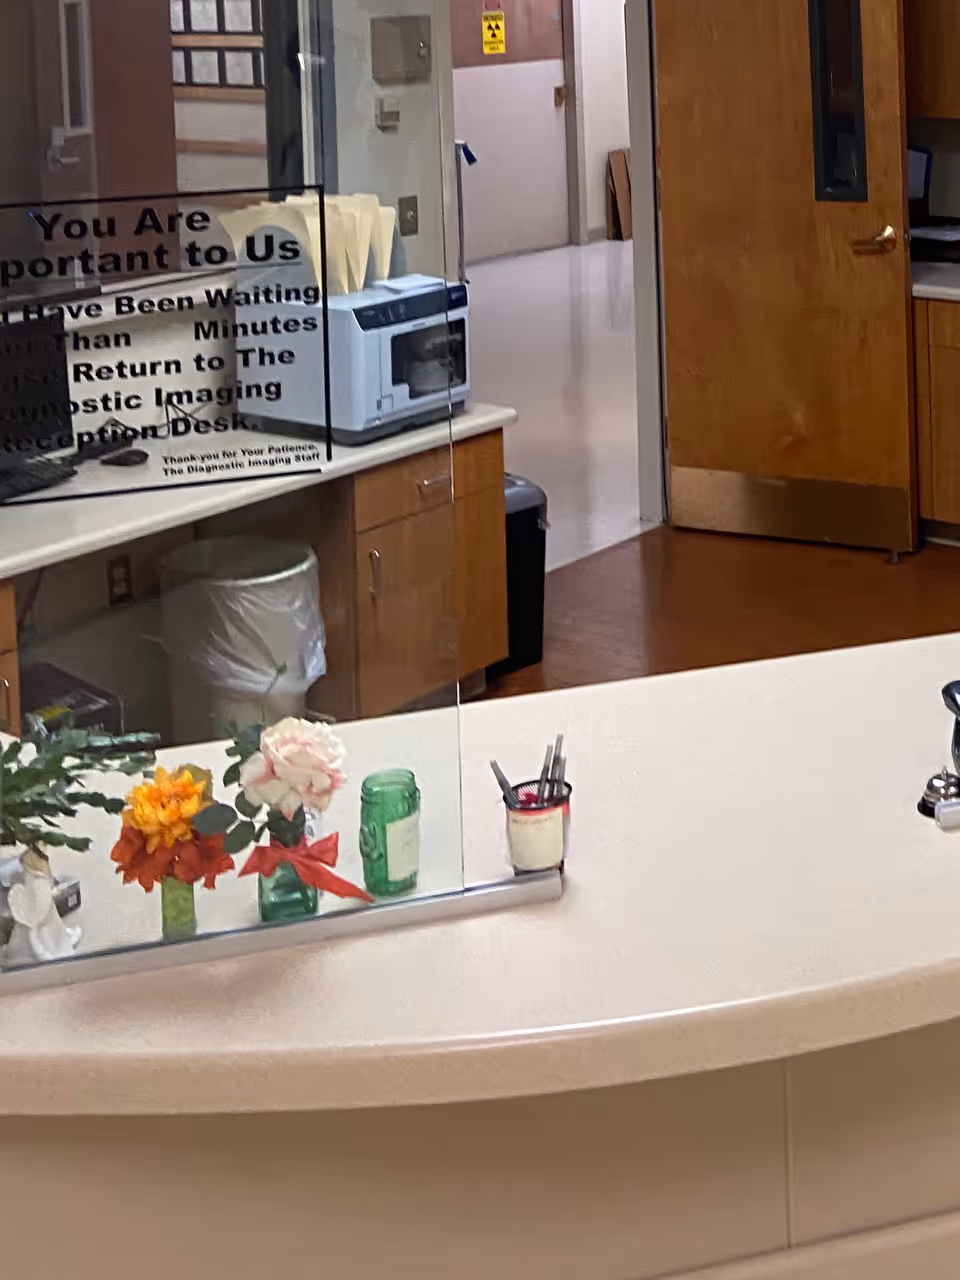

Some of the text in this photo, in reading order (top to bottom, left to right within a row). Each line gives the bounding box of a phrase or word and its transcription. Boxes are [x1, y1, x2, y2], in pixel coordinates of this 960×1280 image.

[35, 208, 211, 241] You Are
[185, 239, 229, 267] to
[245, 234, 301, 262] Us
[23, 303, 103, 323] Have
[115, 294, 195, 316] Been
[204, 283, 320, 308] Waiting
[194, 315, 319, 341] Minutes
[73, 357, 182, 382] Return
[193, 352, 225, 372] to
[235, 348, 296, 368] The
[155, 380, 282, 405] Imaging
[163, 452, 321, 477] The Diagnostic Imaging Staff
[222, 450, 237, 459] for
[240, 446, 264, 457] Your
